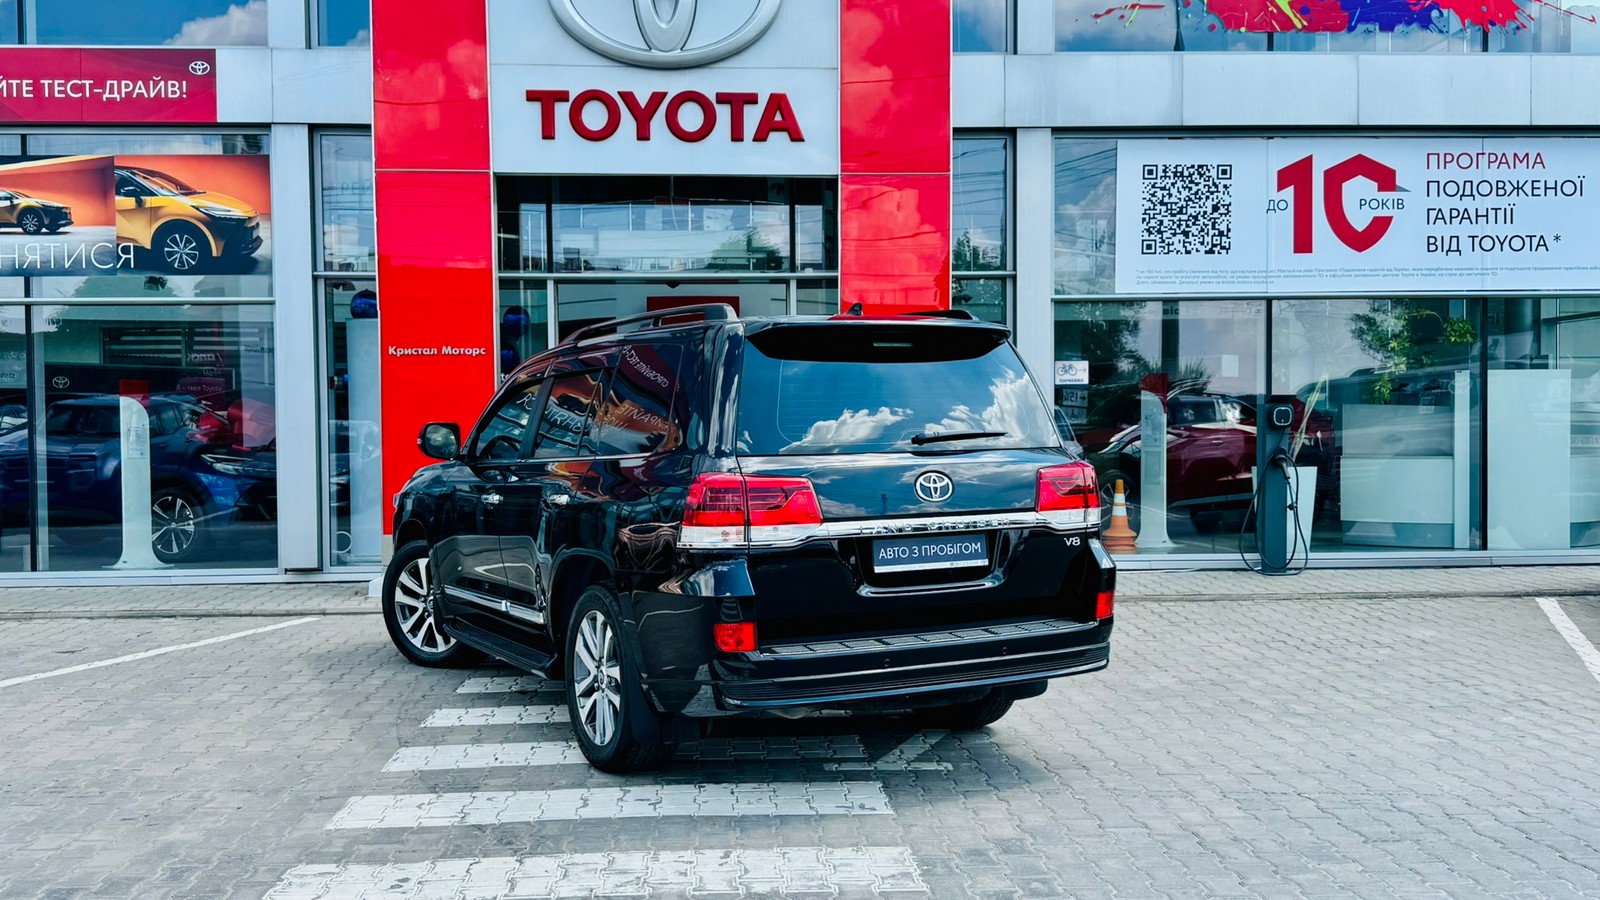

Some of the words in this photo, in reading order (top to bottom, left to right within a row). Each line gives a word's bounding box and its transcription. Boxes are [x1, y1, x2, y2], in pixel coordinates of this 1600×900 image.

[40, 76, 188, 102] ТЕСТ-ДРАЙВ!
[526, 88, 806, 143] TOYOTA
[1426, 152, 1546, 170] ПРОГРАМА
[1426, 175, 1586, 201] ПОДОВЖЕНОЇ
[1266, 199, 1289, 214] ДО
[1359, 198, 1405, 211] РОКІВ
[1426, 203, 1516, 226] ГАРАНТІЇ
[0, 242, 135, 269] НЯТИСЯ
[1426, 235, 1462, 257] ВІД
[388, 345, 438, 357] Кристал
[441, 345, 487, 357] Моторс
[879, 546, 910, 560] АВТО
[922, 542, 982, 557] ПРОБІГОМ
[1063, 536, 1081, 546] V8
